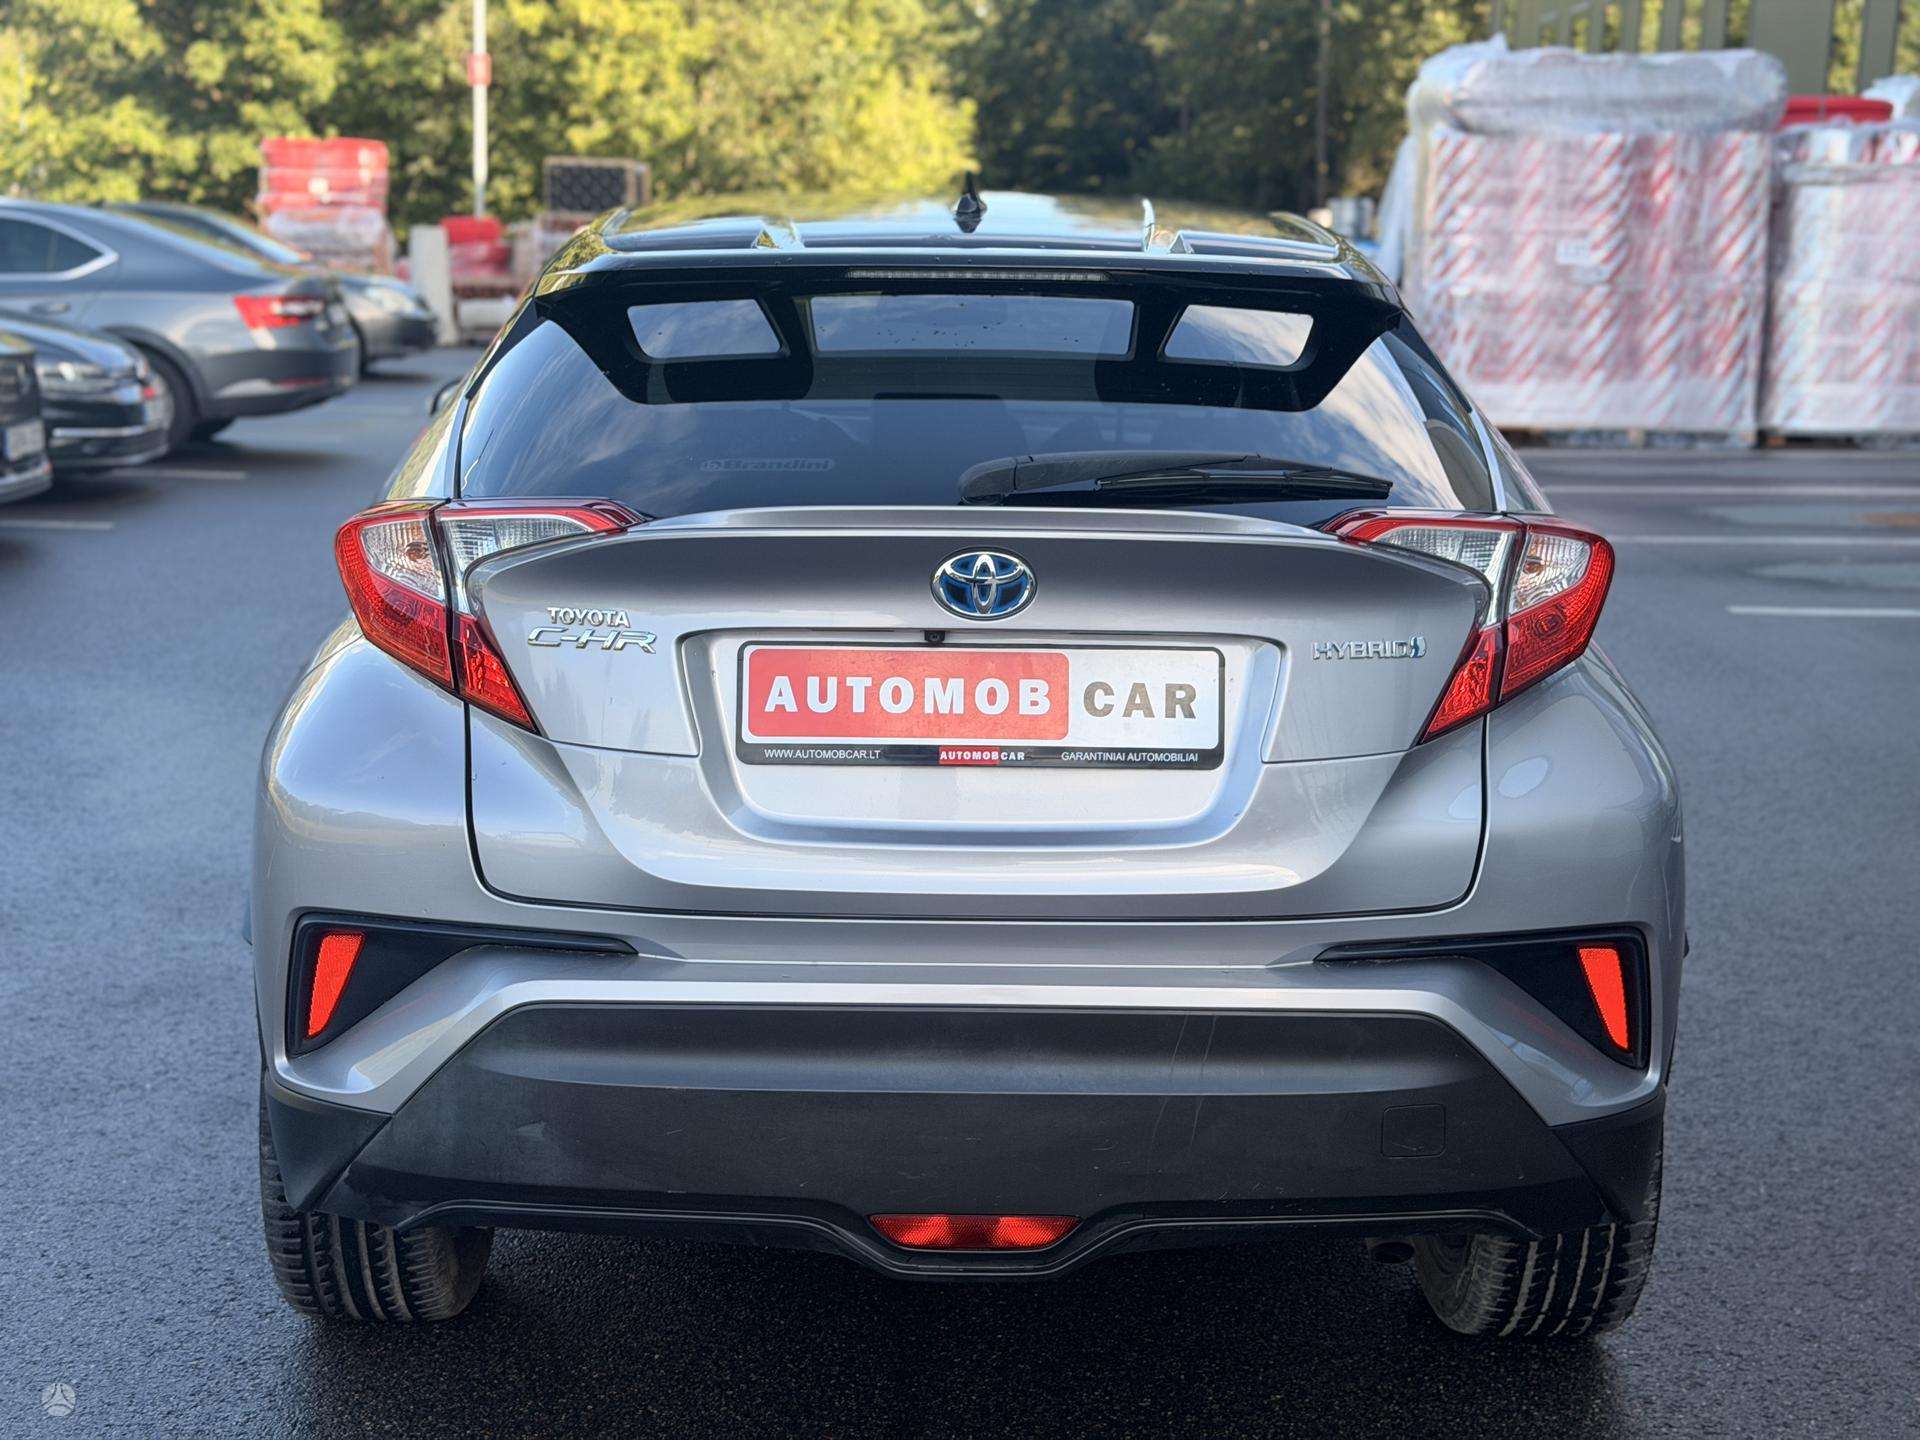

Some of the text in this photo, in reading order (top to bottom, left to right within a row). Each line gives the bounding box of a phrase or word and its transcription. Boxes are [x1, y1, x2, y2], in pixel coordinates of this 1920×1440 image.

[547, 607, 630, 628] TOYOTA
[527, 626, 656, 654] C-HR
[1313, 640, 1407, 660] HYBRID
[764, 675, 1198, 719] AUTOMOB CAR
[764, 748, 881, 760] WWW.AUTOMOBCAR.LT
[1061, 751, 1199, 763] GARANTINIAI AUTOMOBILIAI
